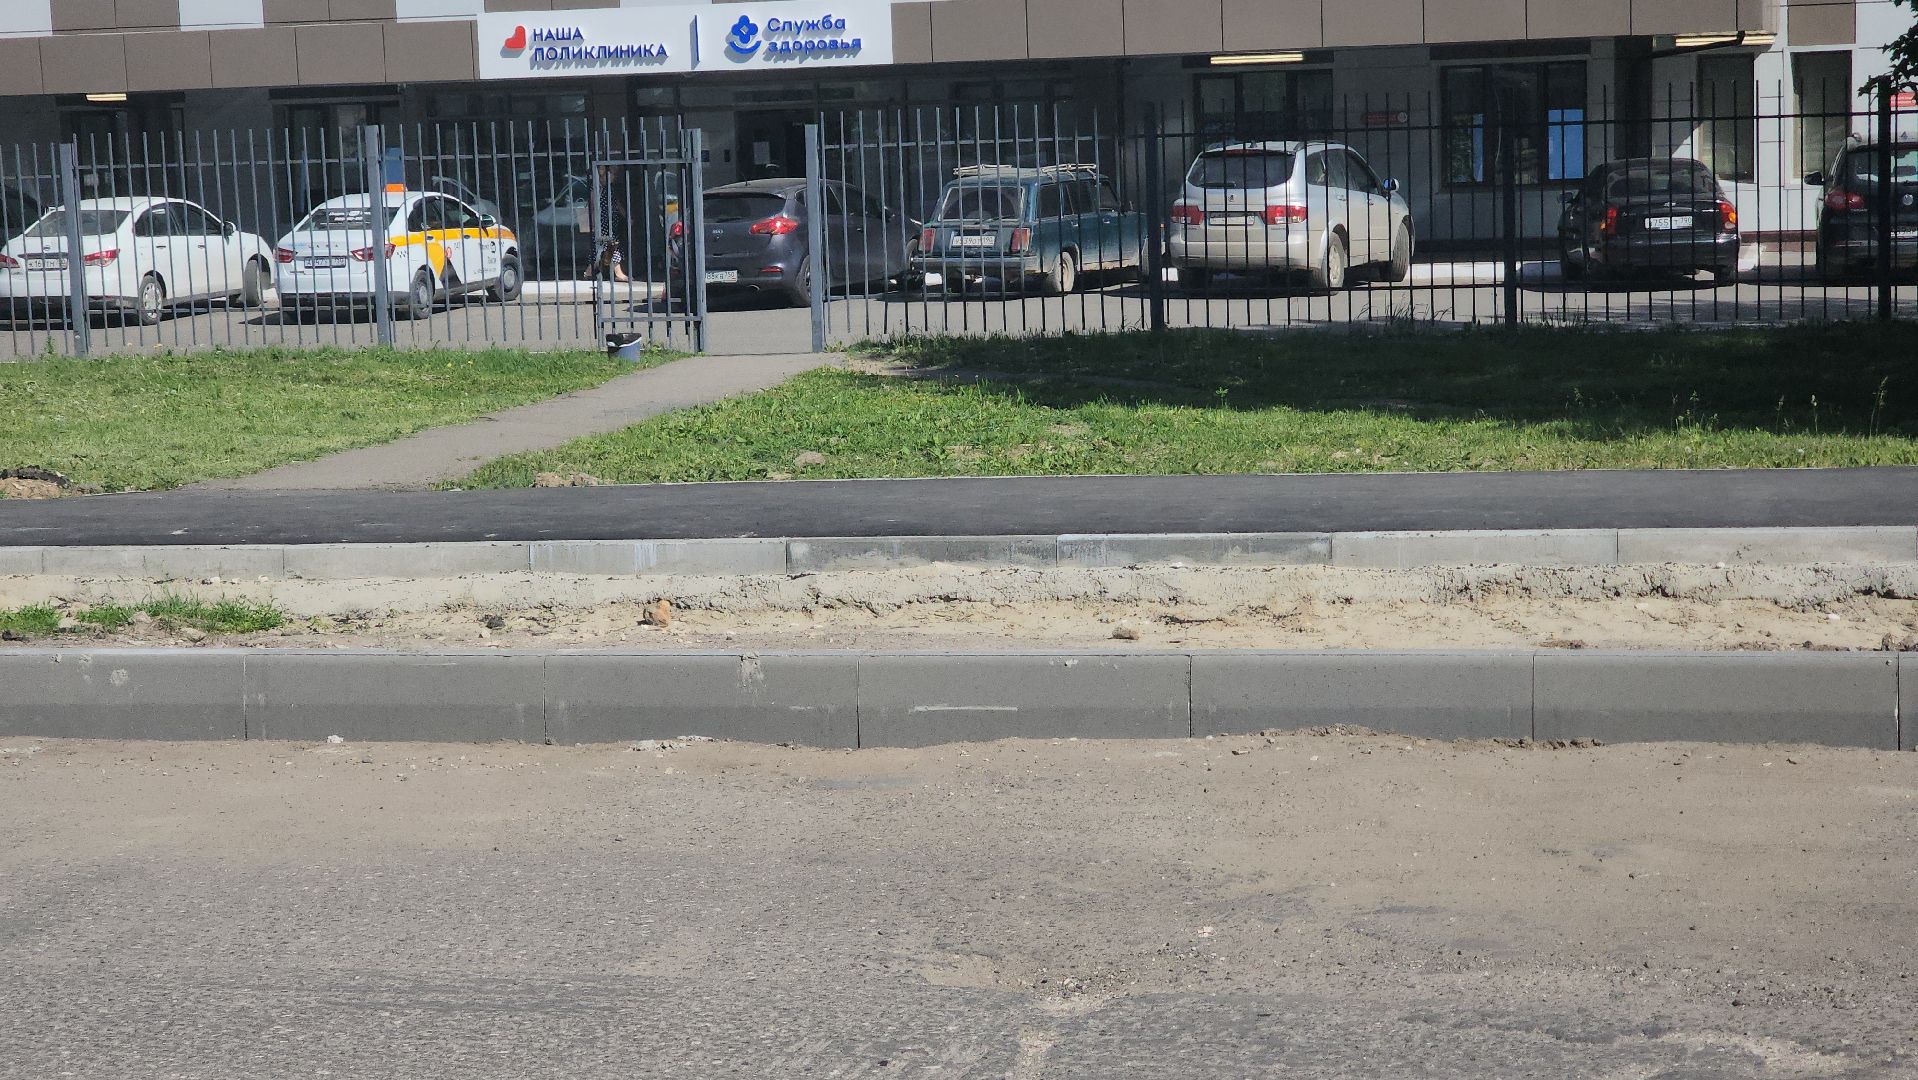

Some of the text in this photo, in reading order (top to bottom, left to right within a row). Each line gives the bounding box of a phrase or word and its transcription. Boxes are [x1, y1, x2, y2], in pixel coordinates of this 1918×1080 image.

[767, 14, 846, 35] Служба
[533, 26, 584, 42] НАША
[534, 43, 669, 62] ПОЛИКЛИНИКА
[768, 38, 862, 55] здоровья
